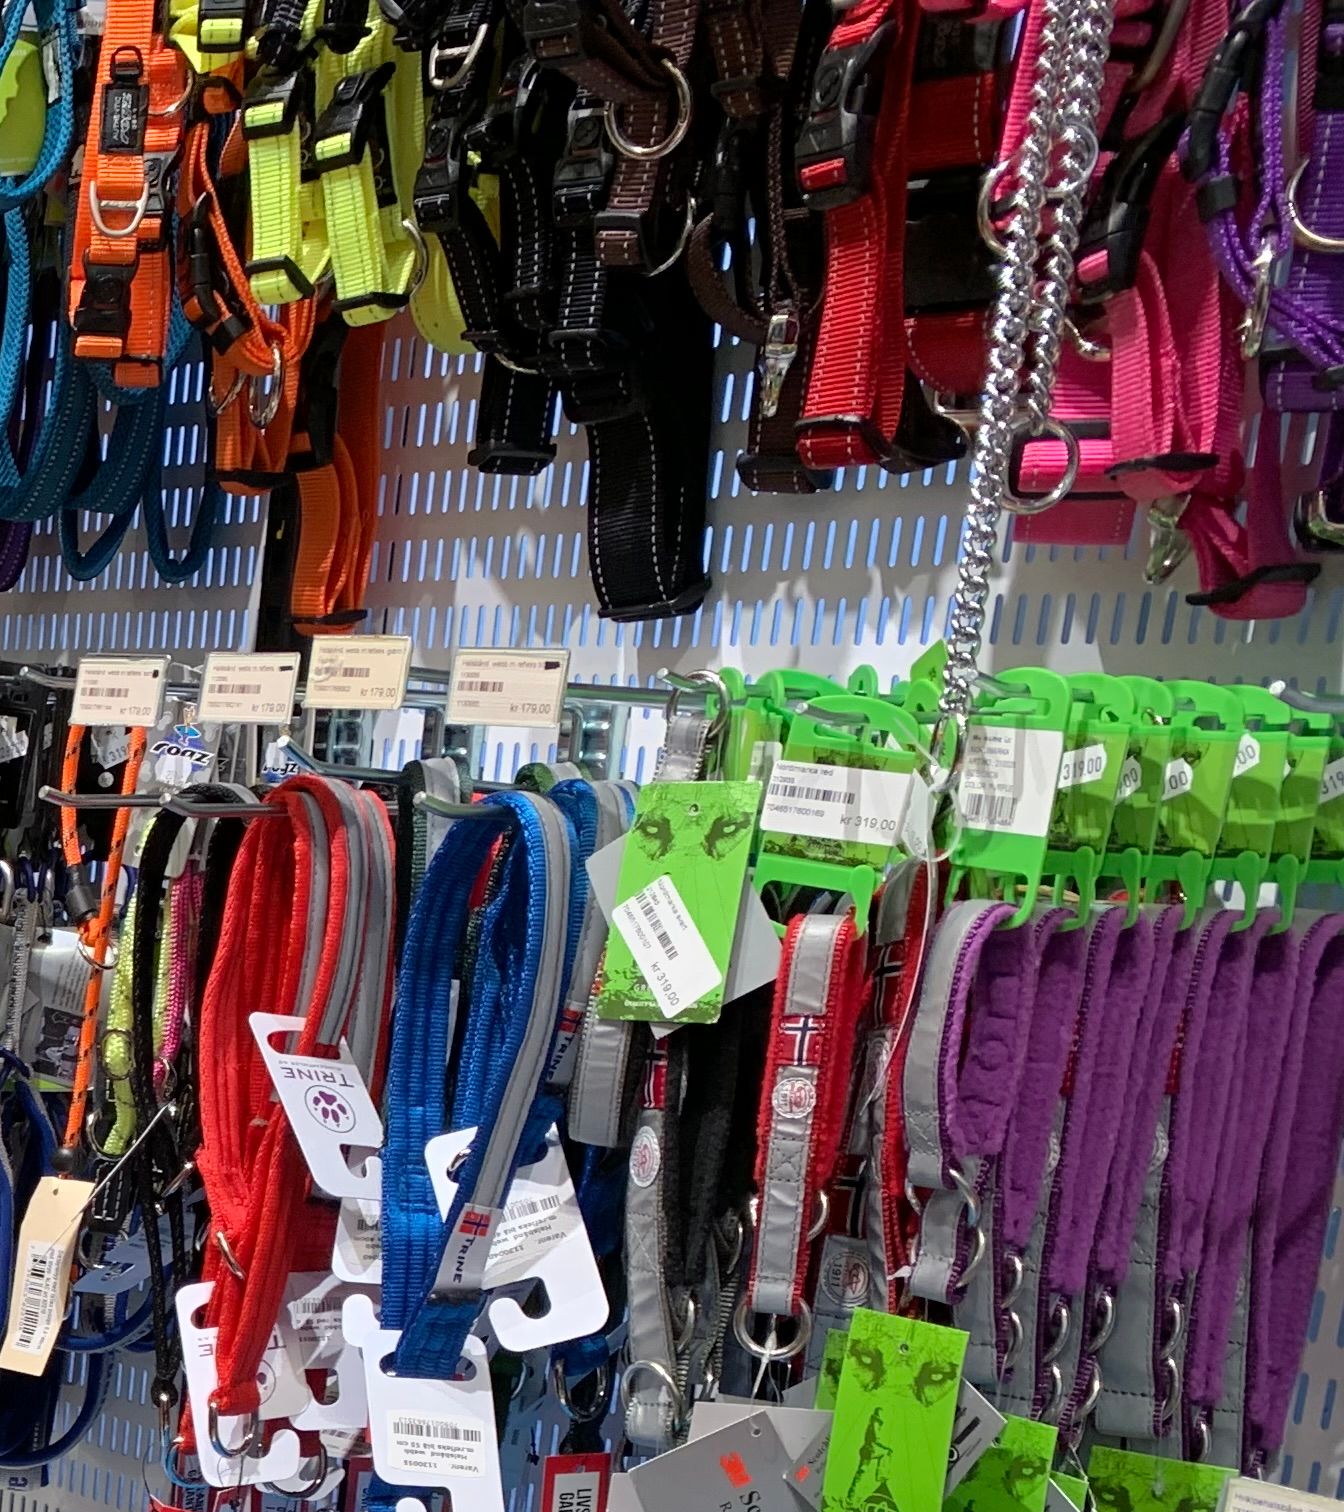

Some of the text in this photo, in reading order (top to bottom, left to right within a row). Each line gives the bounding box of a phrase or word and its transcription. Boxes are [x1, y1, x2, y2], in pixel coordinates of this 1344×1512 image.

[840, 815, 896, 831] kr 319,00
[650, 961, 680, 1007] kr 319,00
[280, 1066, 355, 1089] TRINE
[453, 1236, 476, 1284] TRINE
[720, 1450, 752, 1489] 3M
